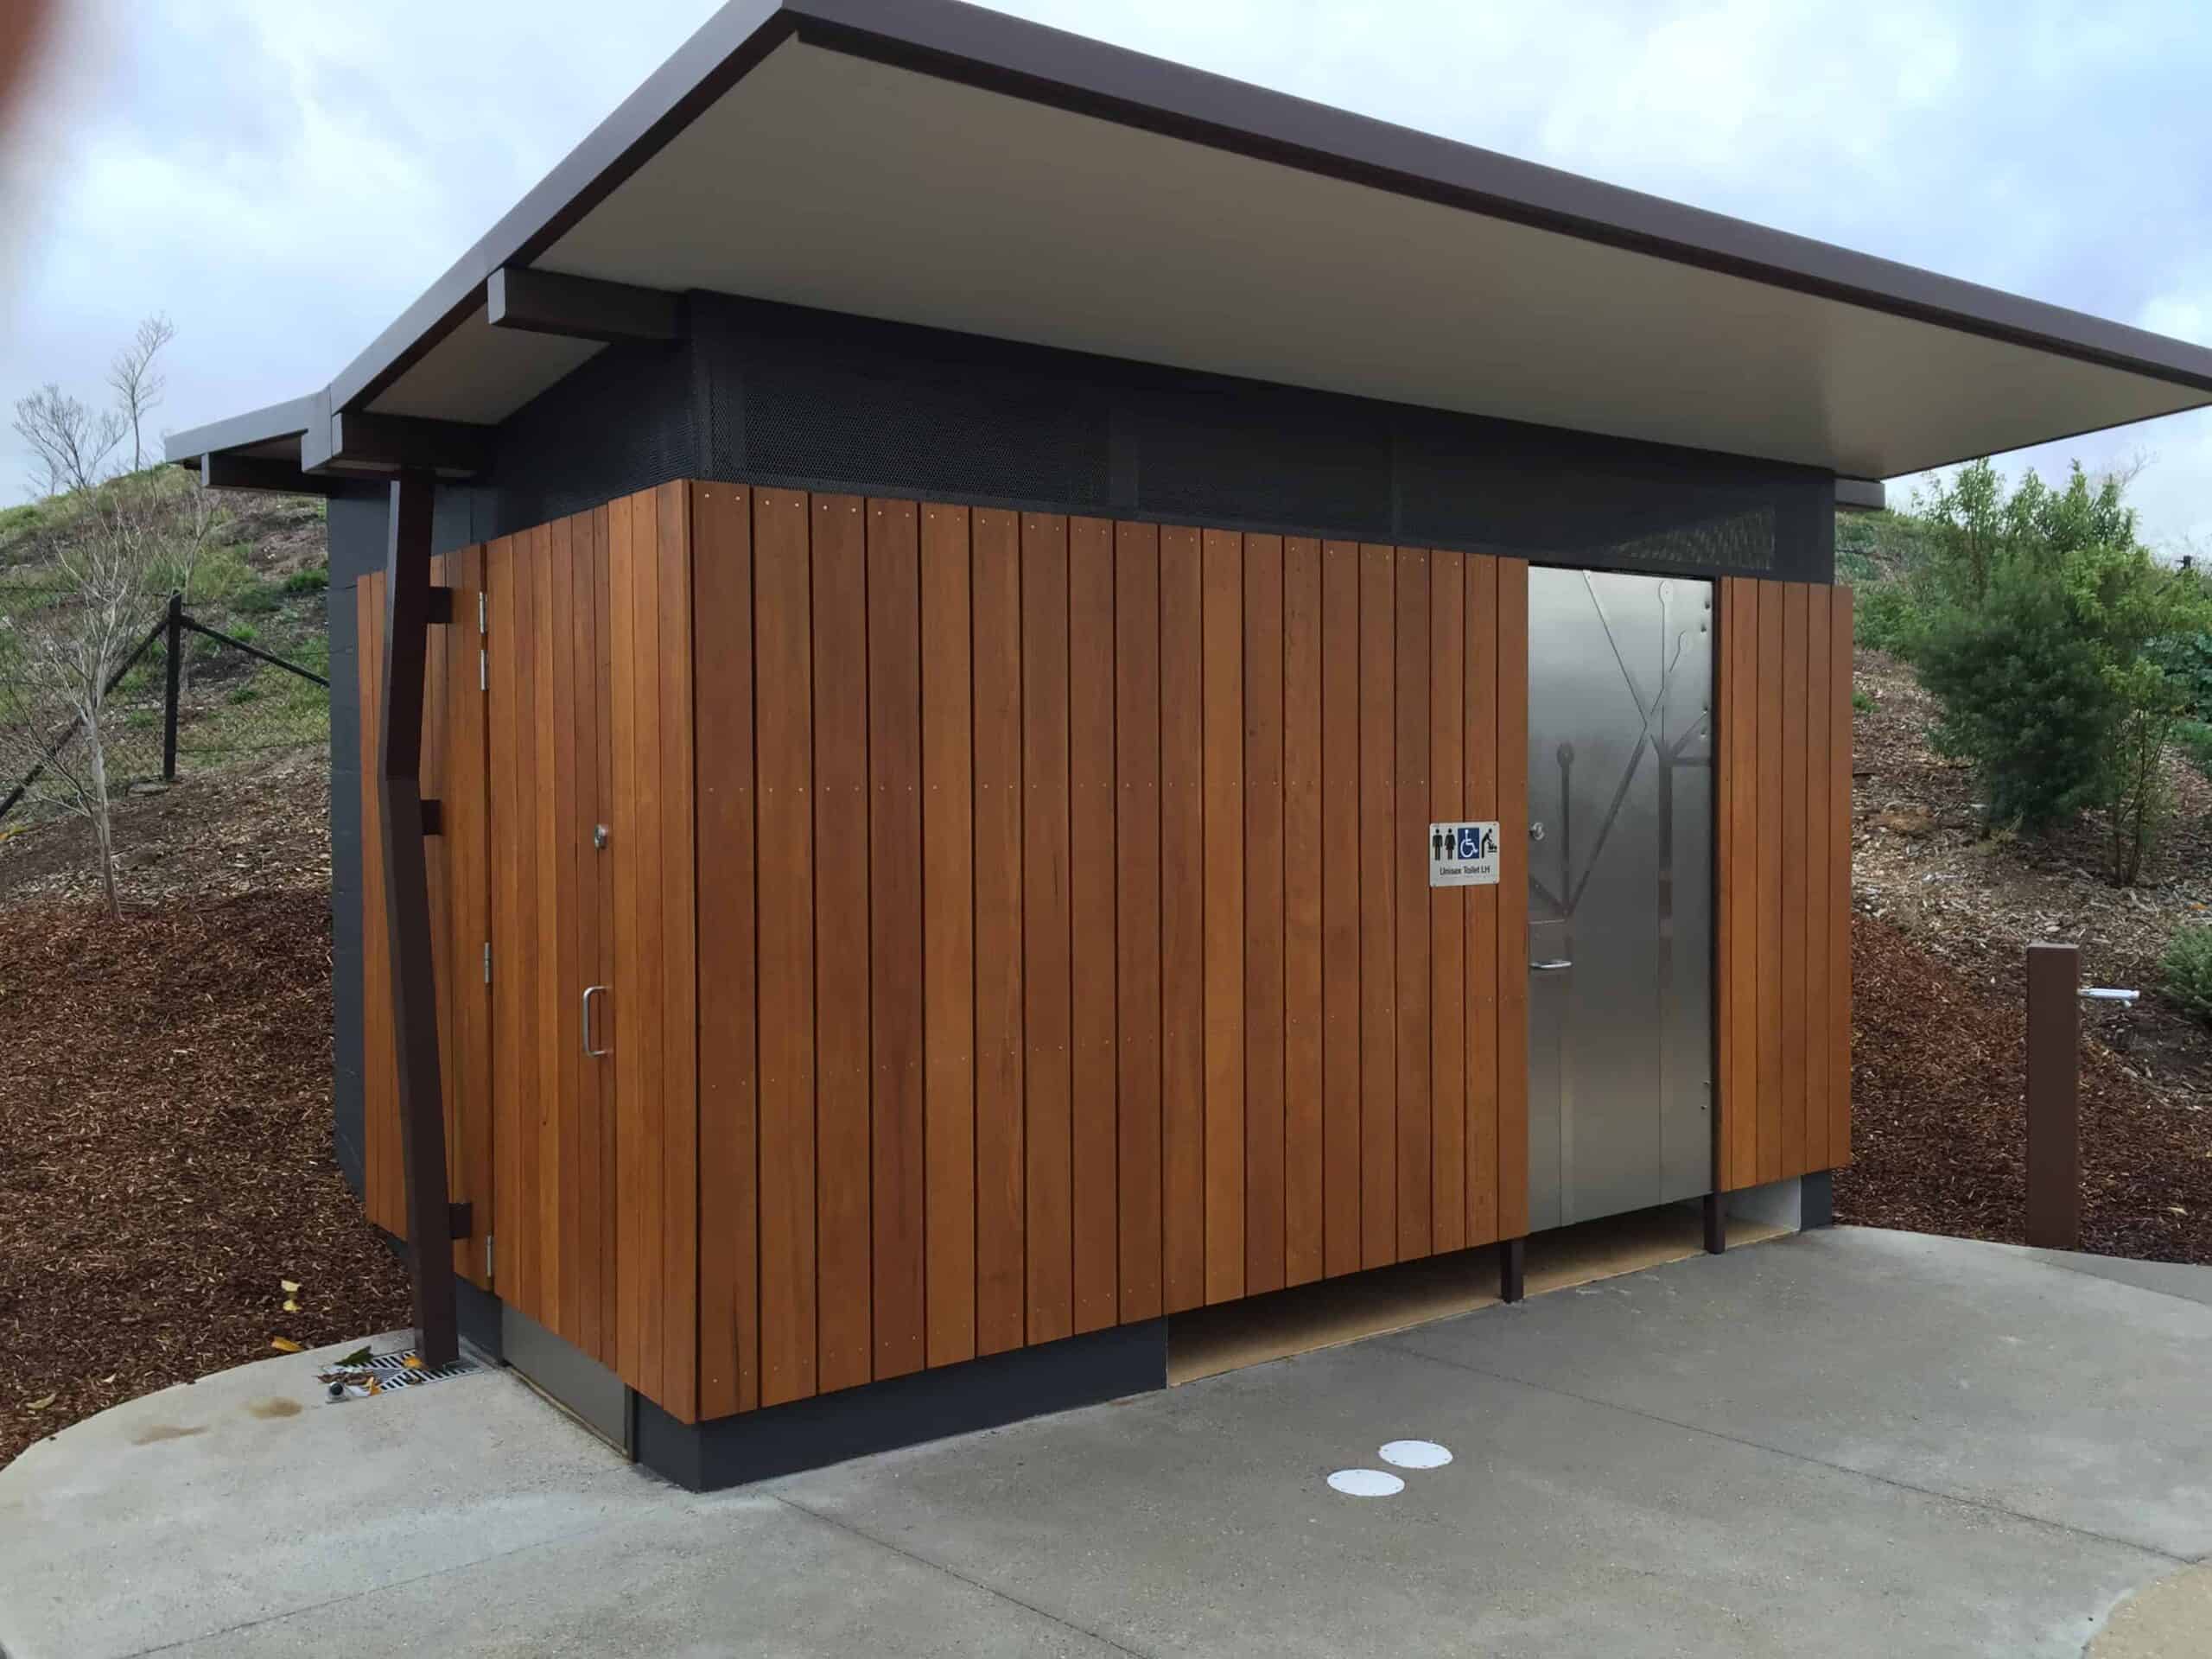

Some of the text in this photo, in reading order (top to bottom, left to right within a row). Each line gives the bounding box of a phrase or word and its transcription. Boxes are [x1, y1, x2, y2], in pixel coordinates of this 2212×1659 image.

[1440, 865, 1491, 875] Unisex Toilet LH
